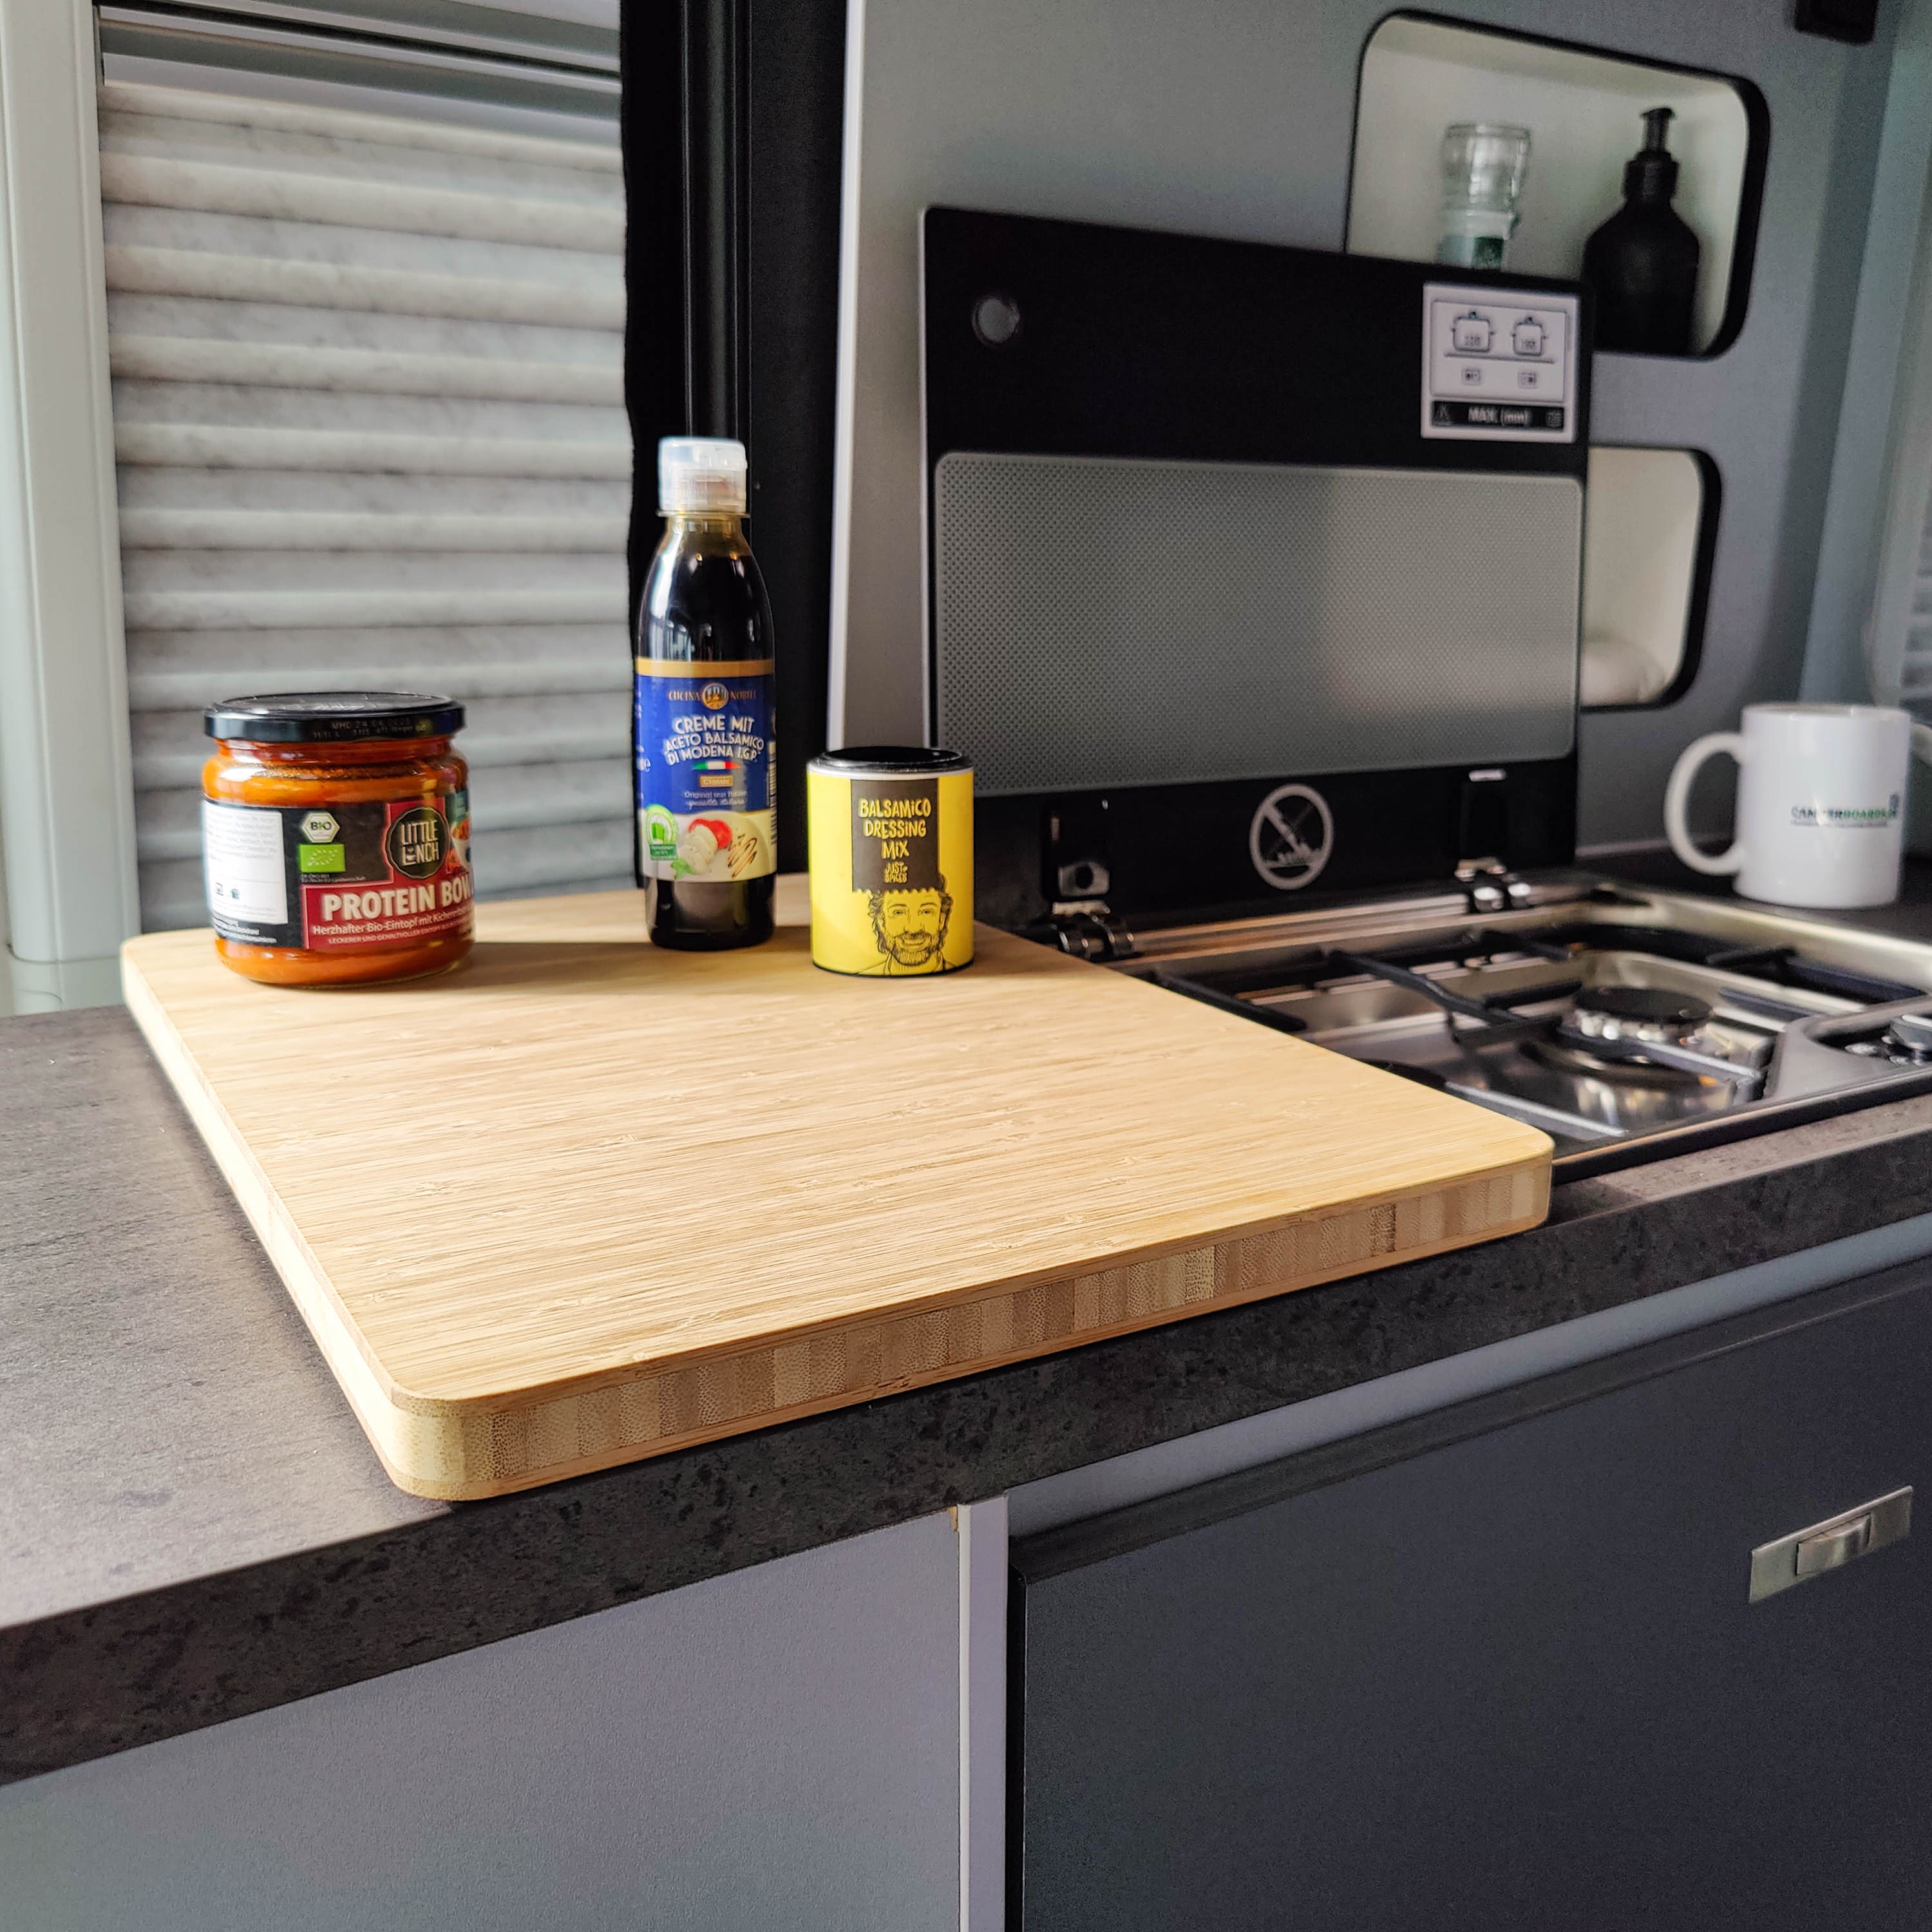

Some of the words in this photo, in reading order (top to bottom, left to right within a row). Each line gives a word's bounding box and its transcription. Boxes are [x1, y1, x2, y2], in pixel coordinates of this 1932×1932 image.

[668, 690, 701, 701] CUCINA
[673, 715, 726, 734] CREME
[730, 715, 755, 733] MIT
[664, 732, 702, 754] ACETO
[705, 732, 764, 752] BALSAMICO
[666, 750, 679, 766] DI
[681, 745, 734, 761] MODENA
[684, 790, 712, 799] Original
[310, 822, 332, 830] BIO
[400, 820, 439, 846] LITTLE
[884, 861, 905, 874] JUST
[323, 884, 436, 922] PROTEIN
[312, 923, 365, 935] Herzhafter
[365, 916, 418, 932] Bio-Eintopf
[419, 914, 432, 925] mit
[328, 936, 361, 945] LECKERER
